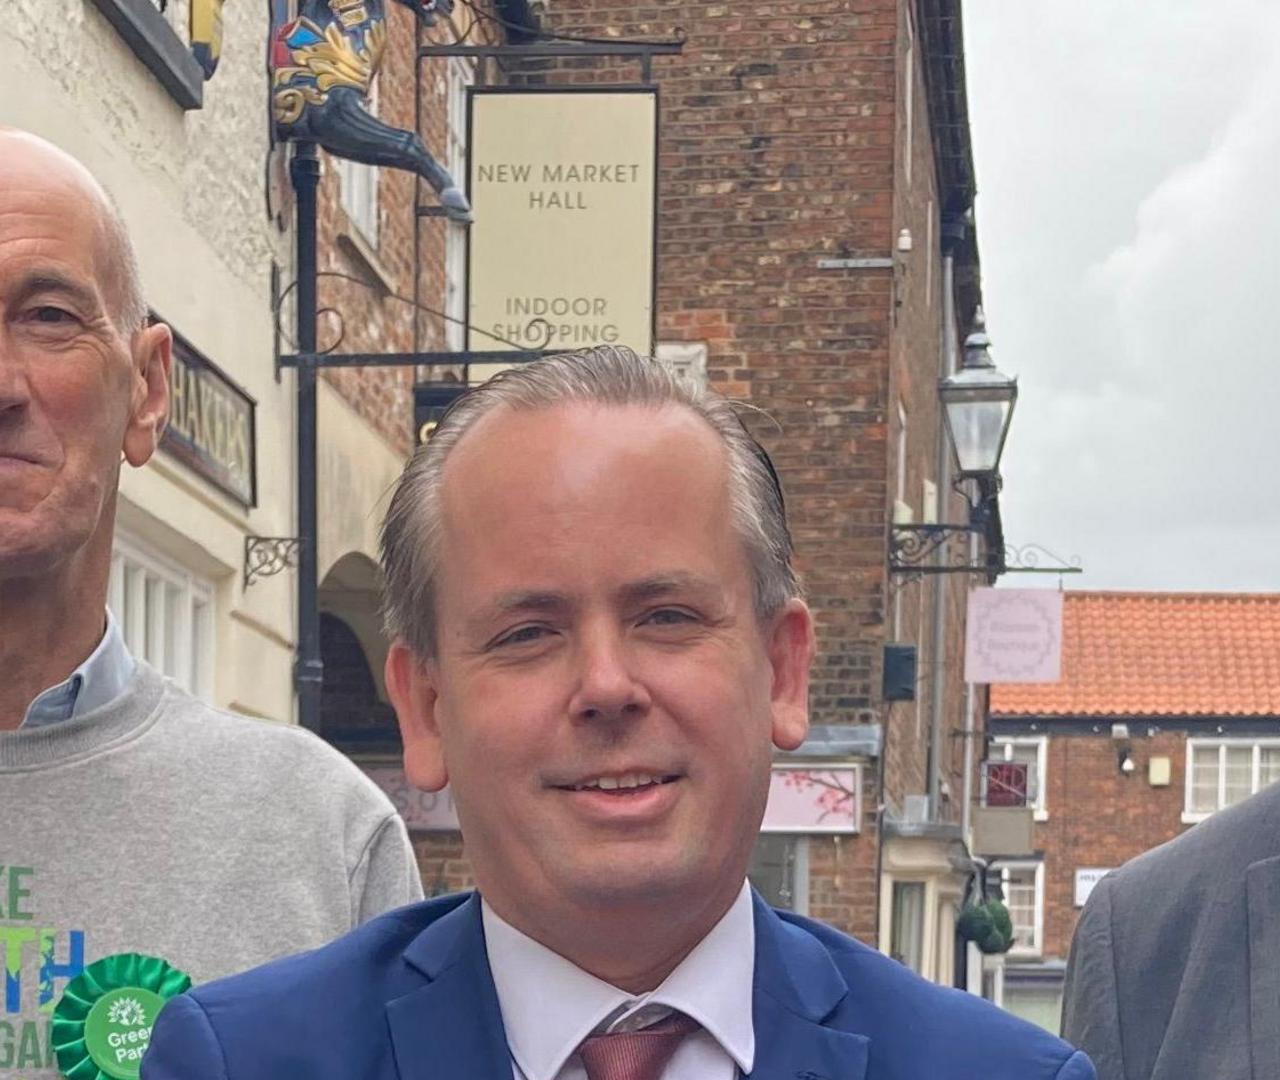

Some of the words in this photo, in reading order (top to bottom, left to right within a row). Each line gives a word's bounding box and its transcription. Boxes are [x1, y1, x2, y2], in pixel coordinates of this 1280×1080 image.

[478, 165, 531, 183] NEW
[543, 165, 639, 183] MARKET
[529, 192, 587, 209] HALL
[506, 298, 607, 316] INDOOR
[492, 324, 619, 342] SHOPPING
